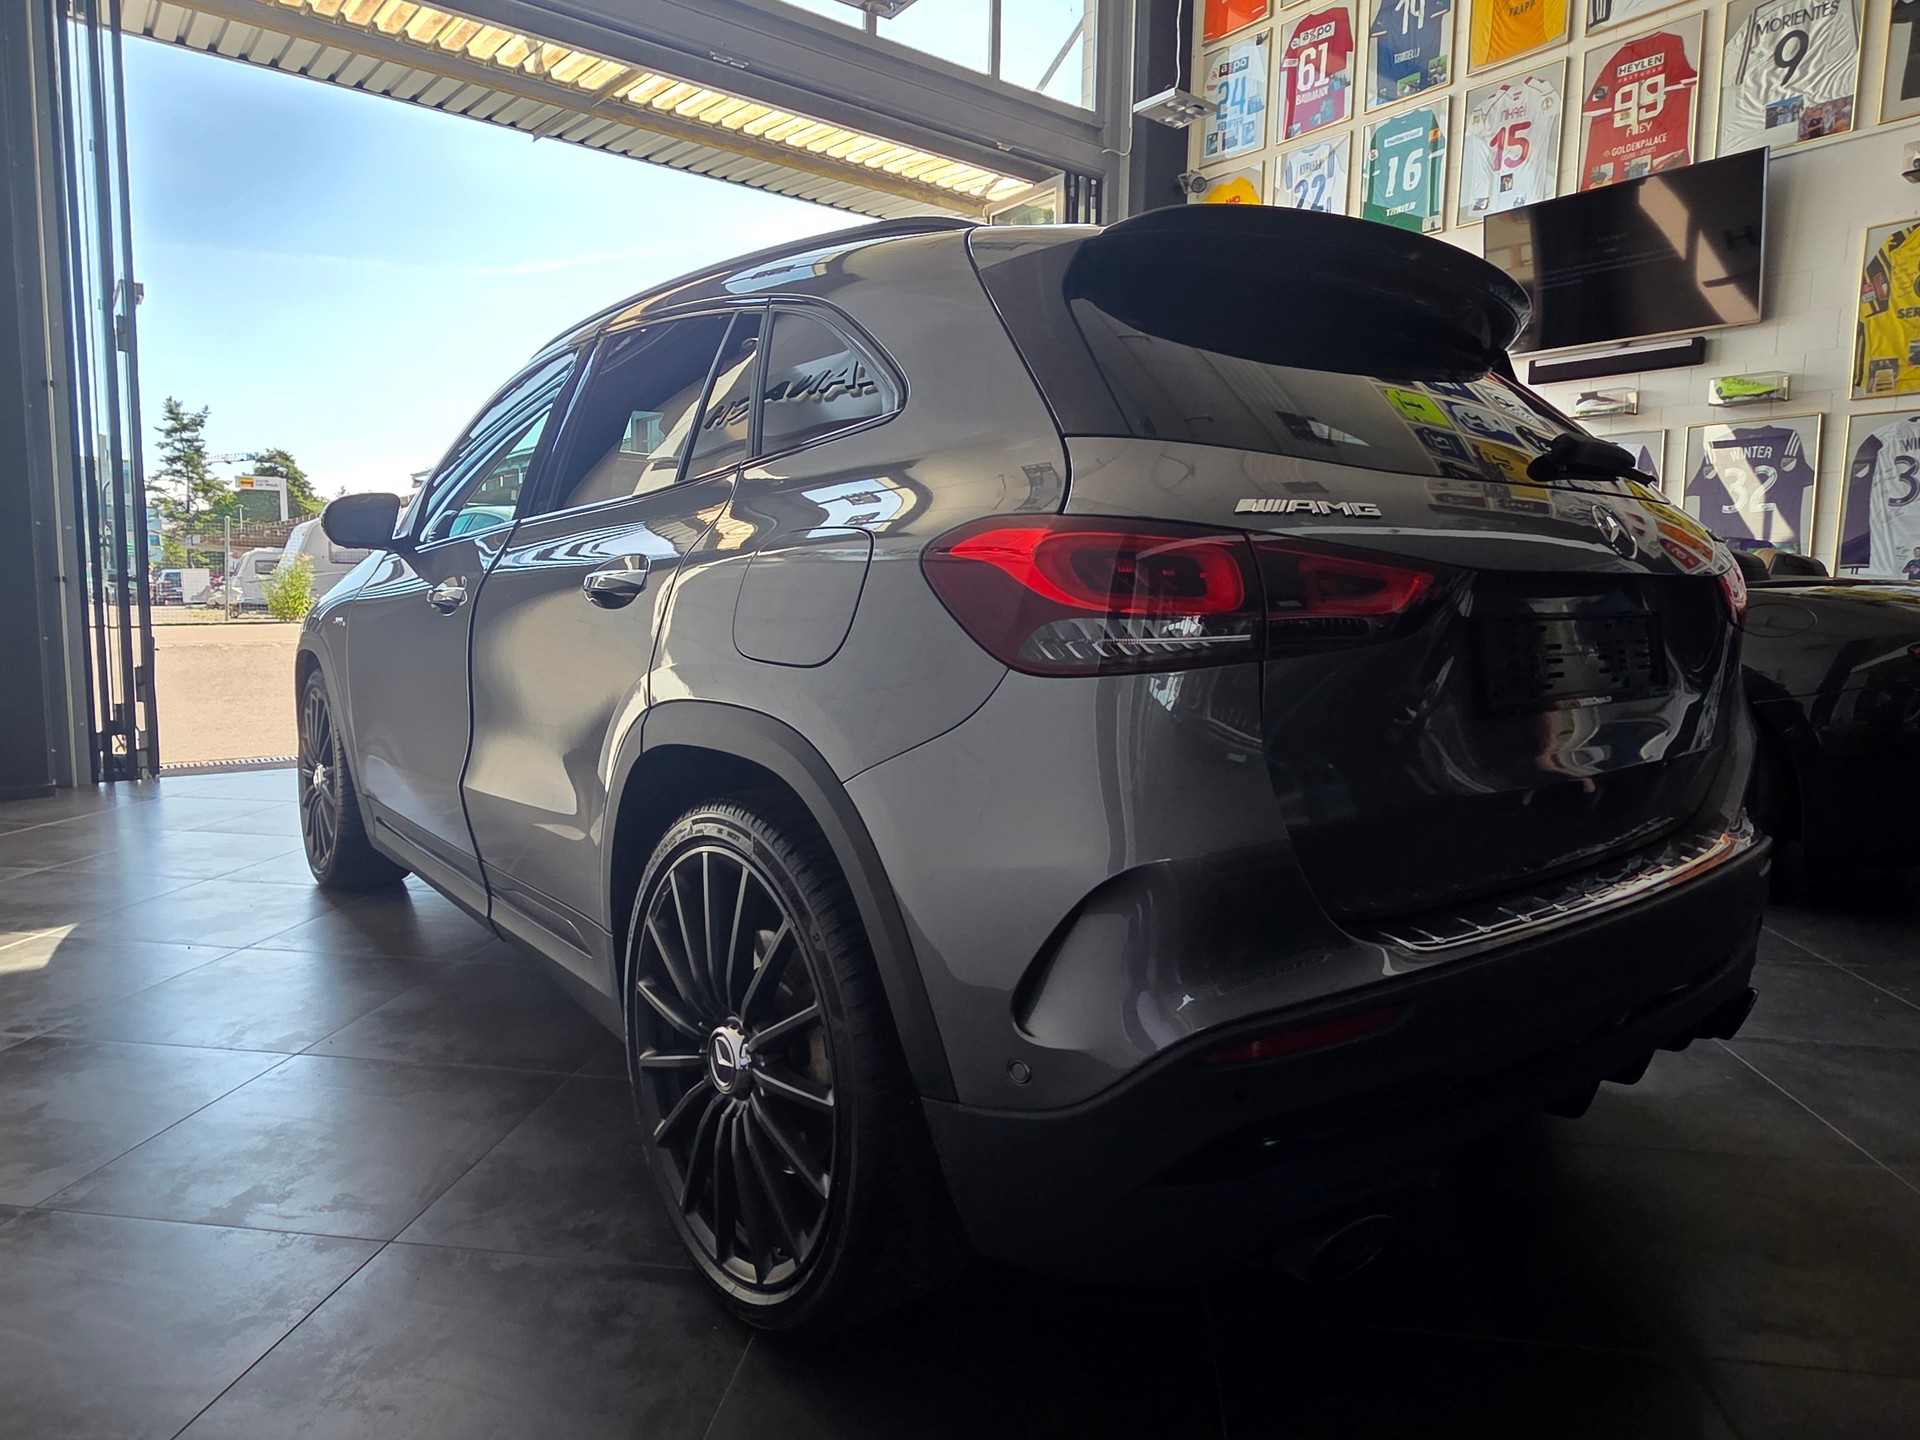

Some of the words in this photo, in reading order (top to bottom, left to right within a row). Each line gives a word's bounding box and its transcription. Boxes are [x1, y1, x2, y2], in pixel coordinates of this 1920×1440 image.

[1508, 0, 1536, 17] TRAPP
[1755, 0, 1840, 36] MORIENTES
[1297, 42, 1329, 92] 61
[1618, 55, 1663, 76] HEYLEN
[1774, 29, 1809, 87] 9
[1216, 76, 1246, 120] 24
[1613, 74, 1666, 128] 99
[1490, 121, 1532, 171] 15
[1611, 132, 1668, 157] GOLDENPALACE
[1294, 174, 1326, 210] 22
[1385, 148, 1423, 197] 16
[1730, 445, 1773, 461] WINTER
[1286, 499, 1383, 518] AMG
[1722, 465, 1778, 513] 32
